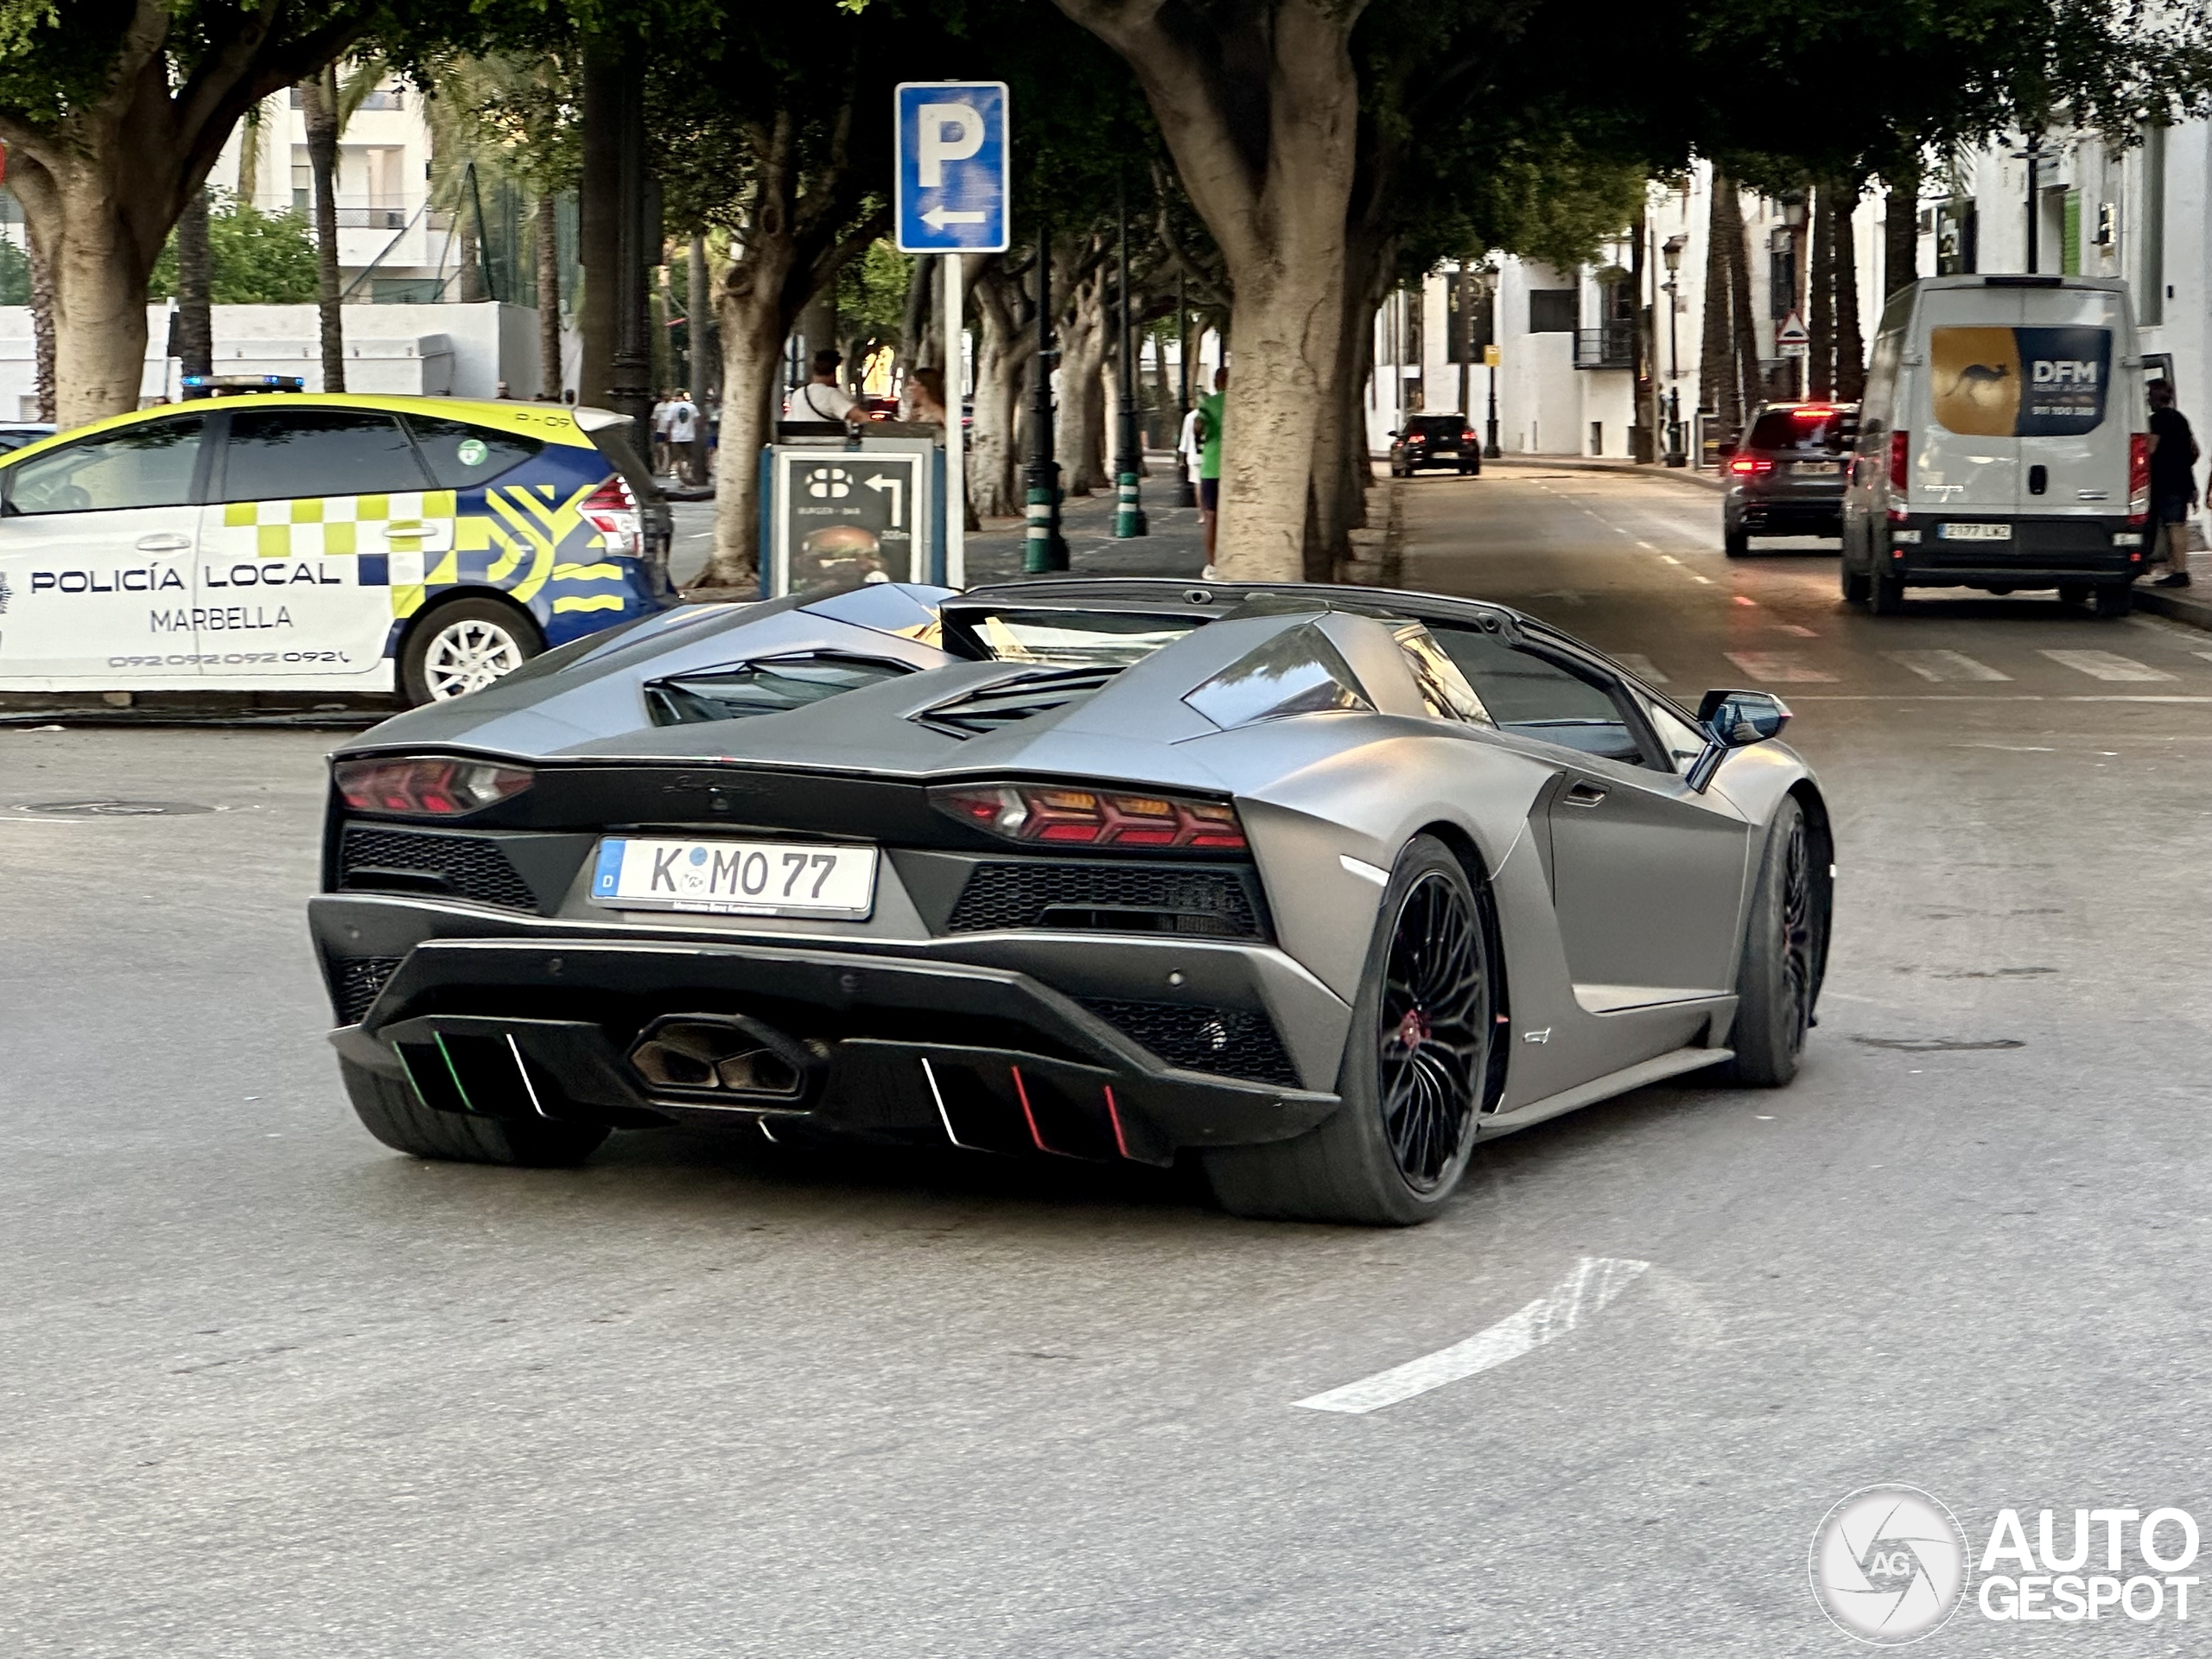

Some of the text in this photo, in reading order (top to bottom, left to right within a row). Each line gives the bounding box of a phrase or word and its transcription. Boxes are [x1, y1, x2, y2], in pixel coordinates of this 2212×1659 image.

[918, 104, 985, 187] P
[2032, 360, 2097, 383] DFM
[30, 563, 340, 594] POLICÍA LOCAL
[150, 606, 294, 632] MARBELLA
[602, 875, 613, 887] D
[651, 848, 837, 899] K MO 77
